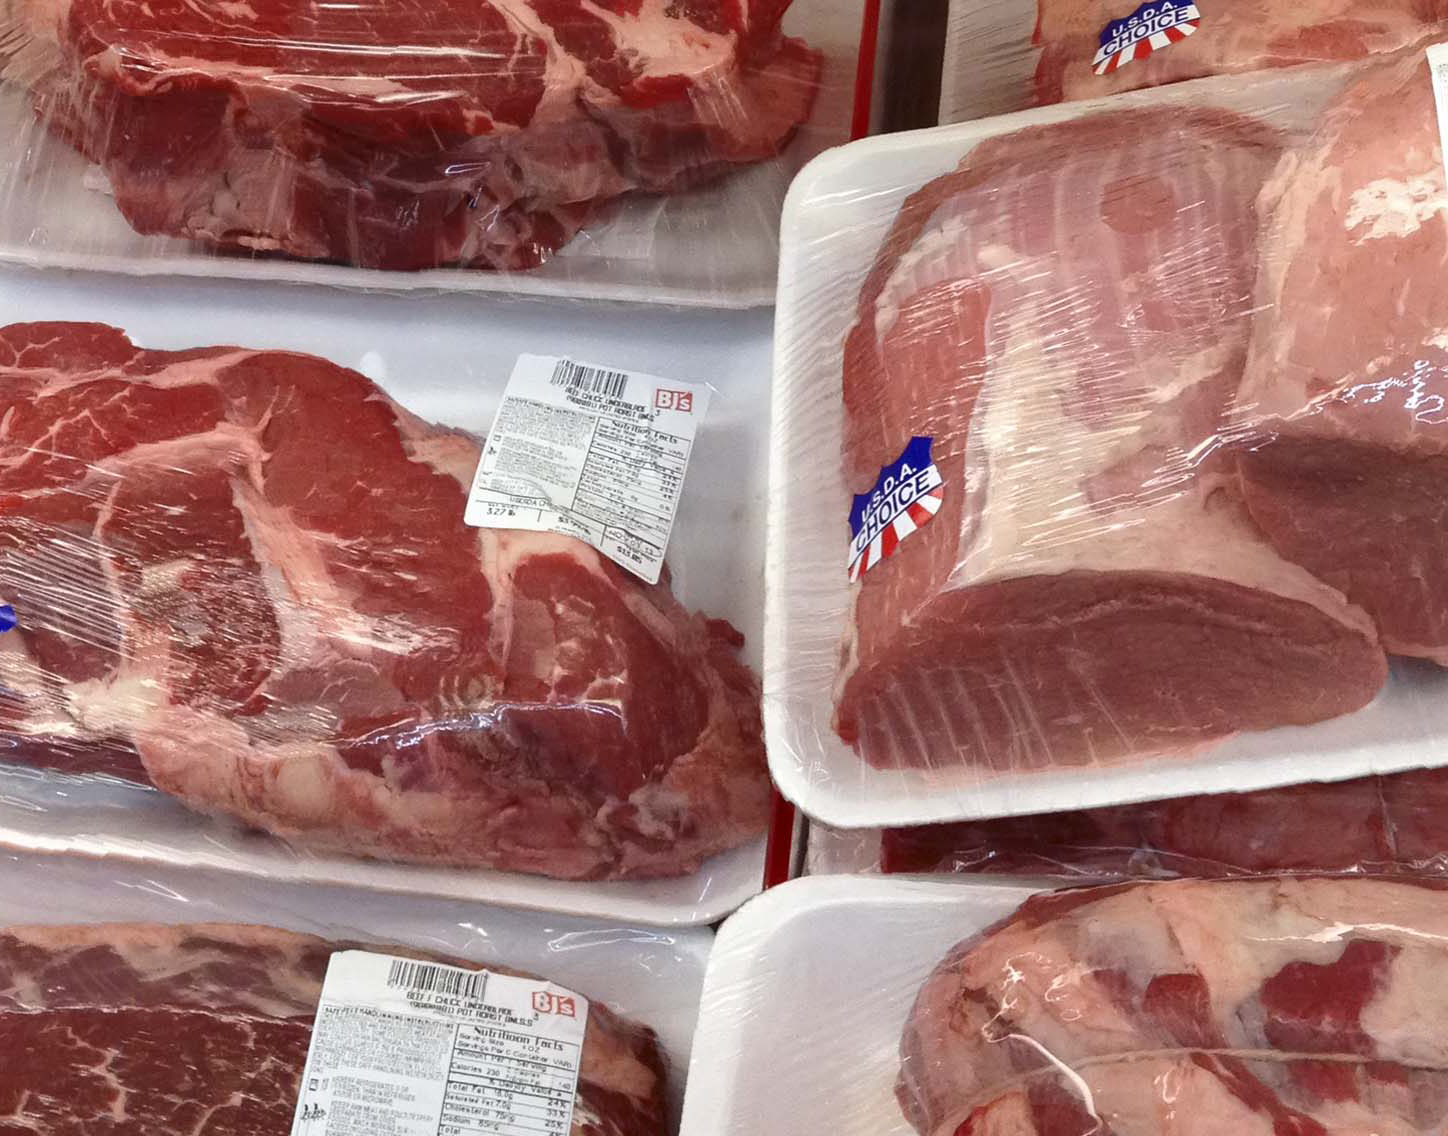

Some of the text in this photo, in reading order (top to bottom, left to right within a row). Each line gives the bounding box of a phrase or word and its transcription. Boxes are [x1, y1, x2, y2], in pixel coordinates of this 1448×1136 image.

[1103, 6, 1189, 56] CHOICE
[1112, 1, 1178, 38] U.S.D.A.
[855, 469, 931, 553] CHOICE
[862, 464, 918, 523] U.S.D.A.
